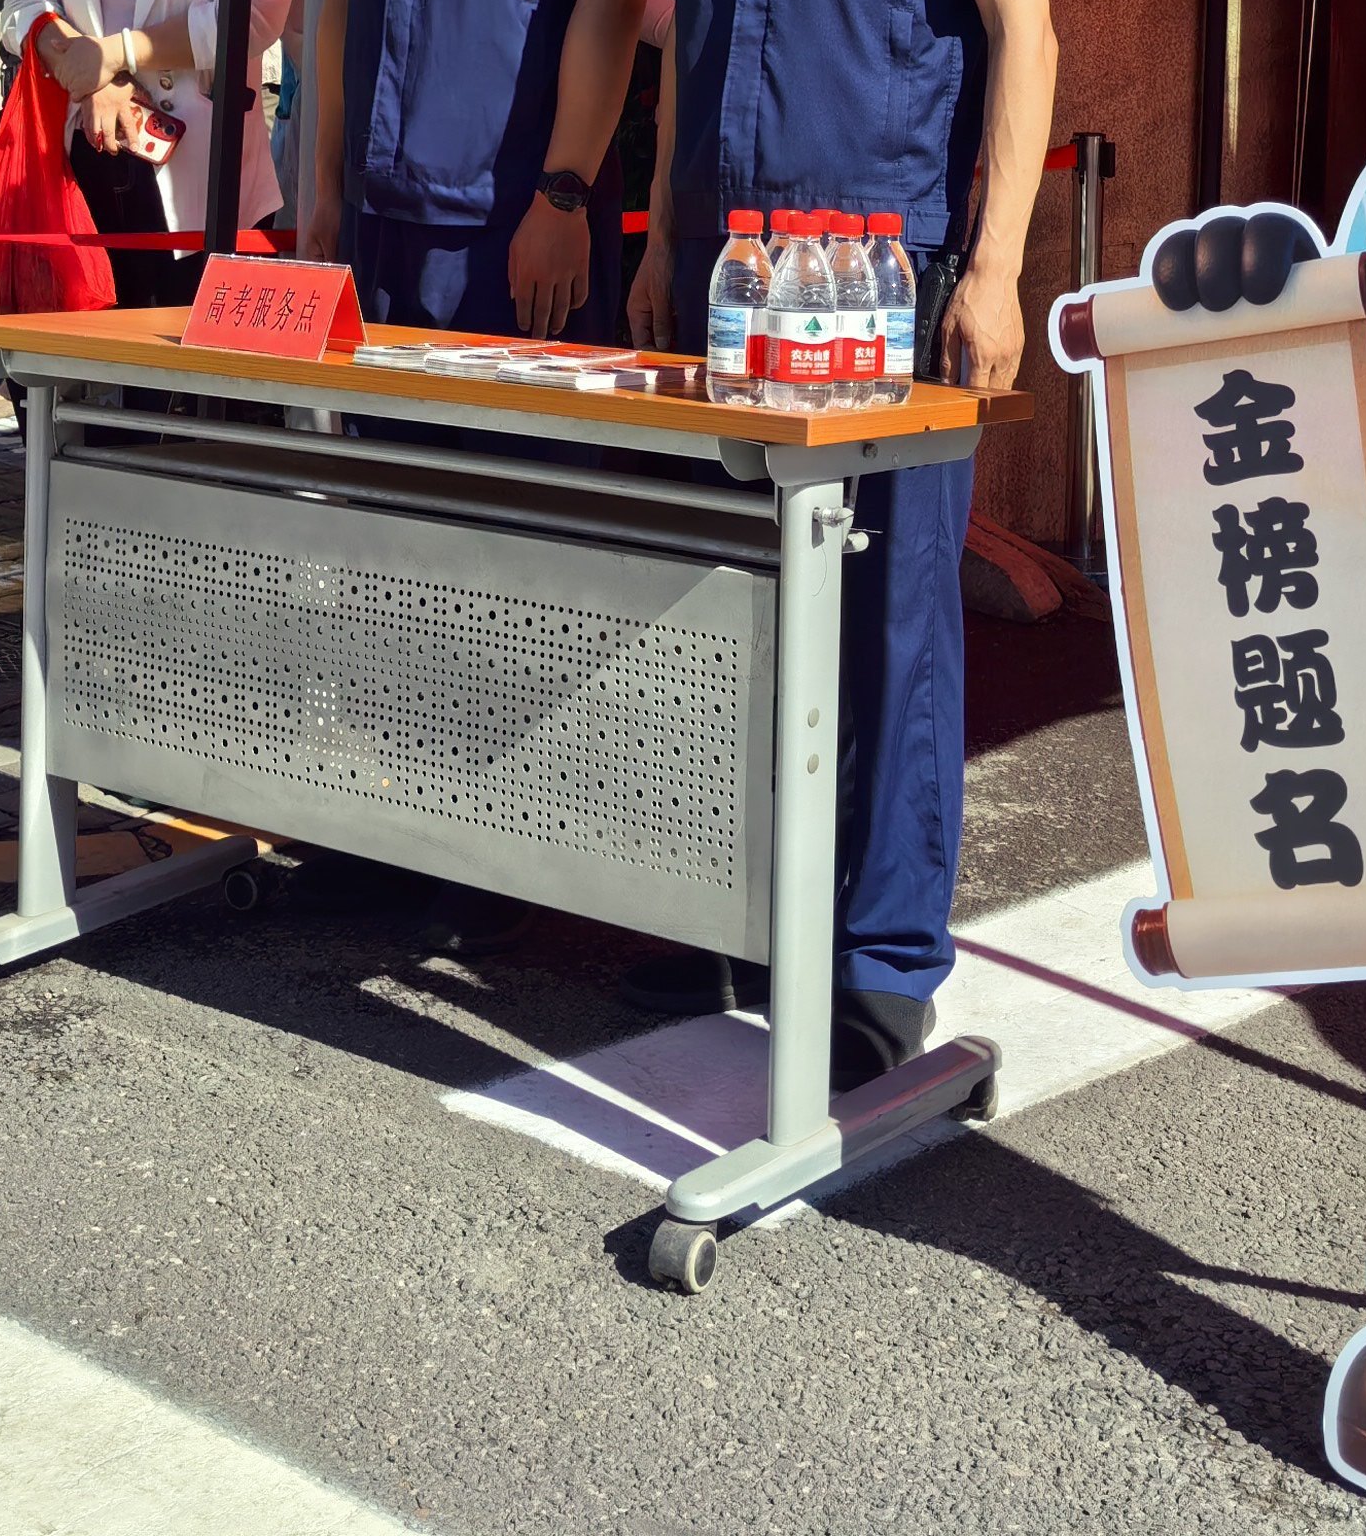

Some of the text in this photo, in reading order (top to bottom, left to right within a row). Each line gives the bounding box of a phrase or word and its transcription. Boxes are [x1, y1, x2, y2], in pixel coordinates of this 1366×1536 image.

[204, 281, 321, 333] 高考服务点
[1192, 368, 1366, 890] 金榜题名
